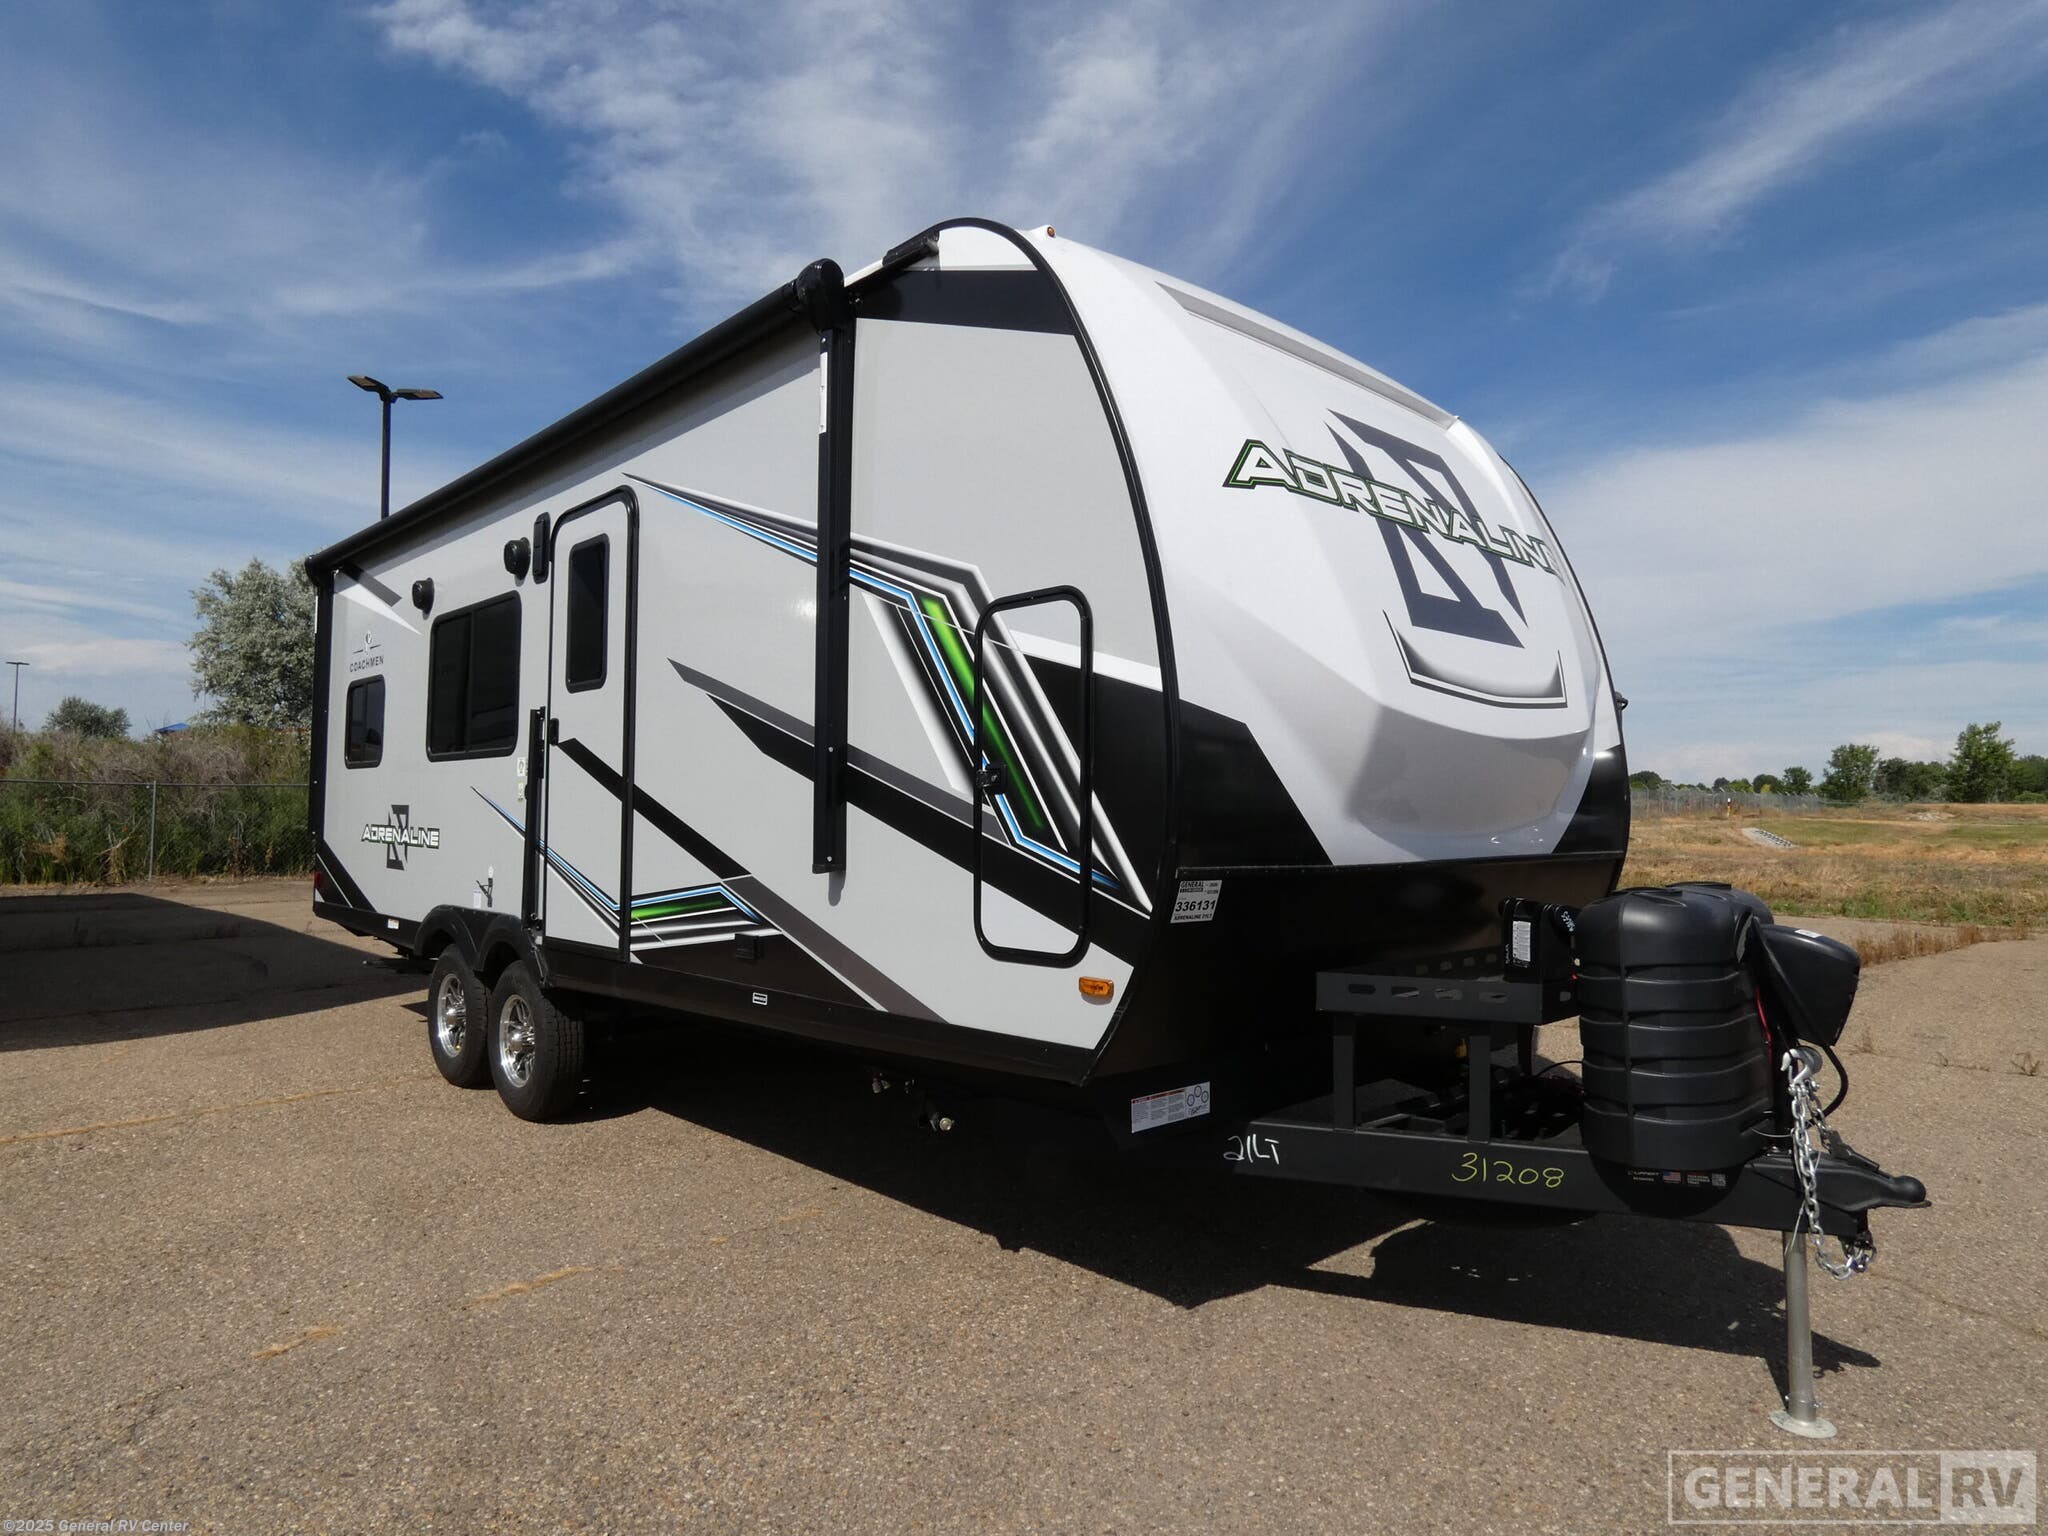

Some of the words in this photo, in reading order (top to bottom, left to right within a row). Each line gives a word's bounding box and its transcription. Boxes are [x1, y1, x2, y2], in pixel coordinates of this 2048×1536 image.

[350, 656, 384, 672] COACHMEN
[361, 823, 440, 849] ADRENALINE
[1175, 900, 1216, 912] 336131
[1224, 1133, 1280, 1165] 21LT
[1451, 1152, 1565, 1188] 31208
